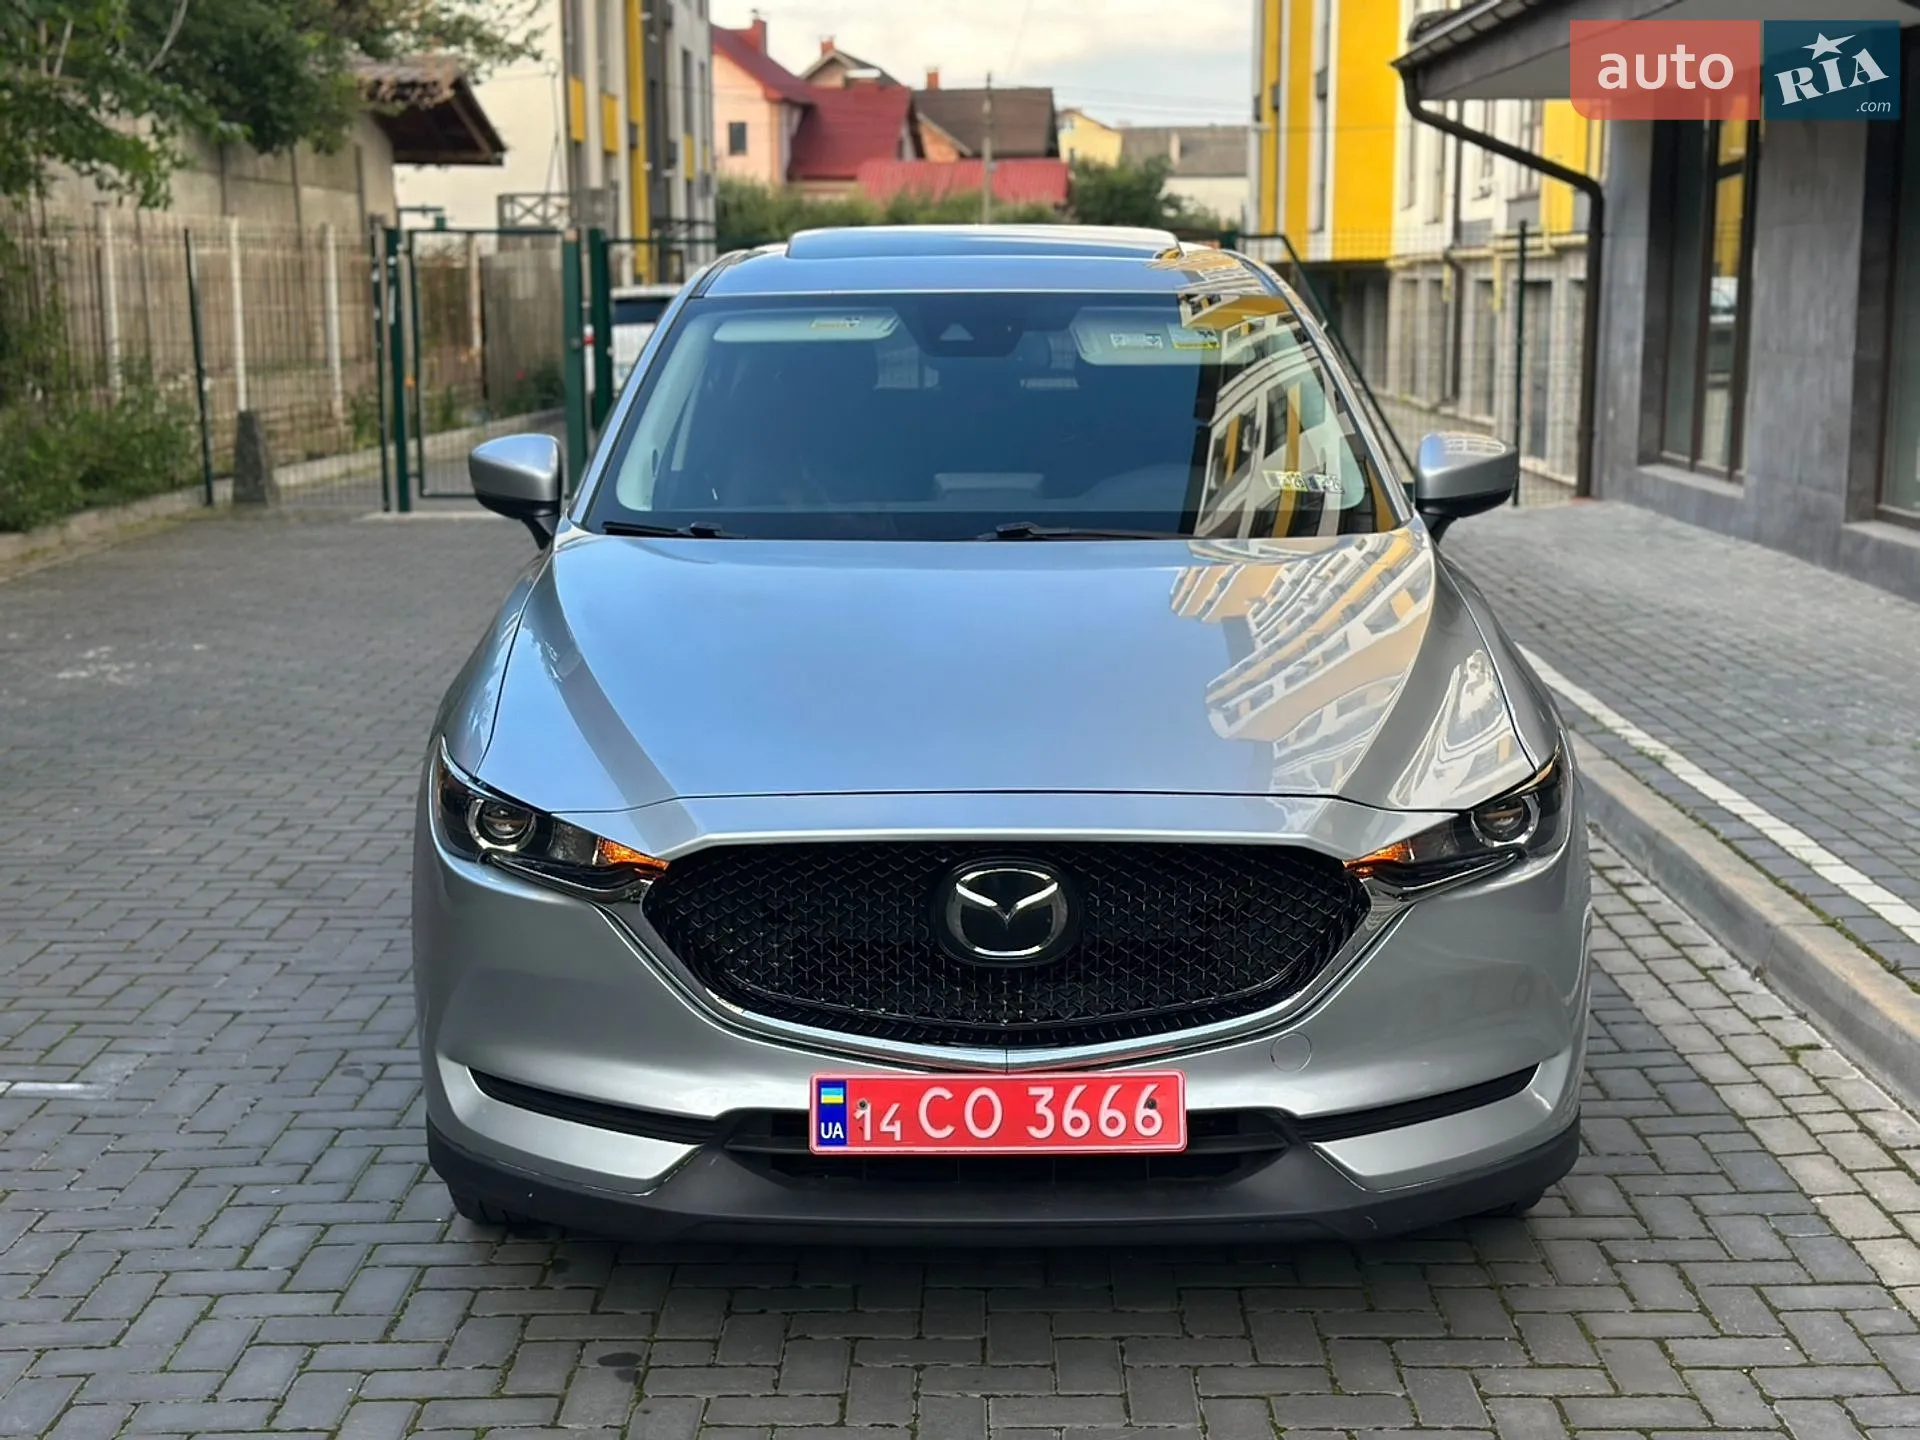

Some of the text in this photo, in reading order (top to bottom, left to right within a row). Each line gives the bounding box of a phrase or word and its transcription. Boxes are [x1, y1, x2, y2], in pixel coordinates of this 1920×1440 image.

[820, 1122, 845, 1140] UA
[853, 1084, 1164, 1142] 14 CO 3666
